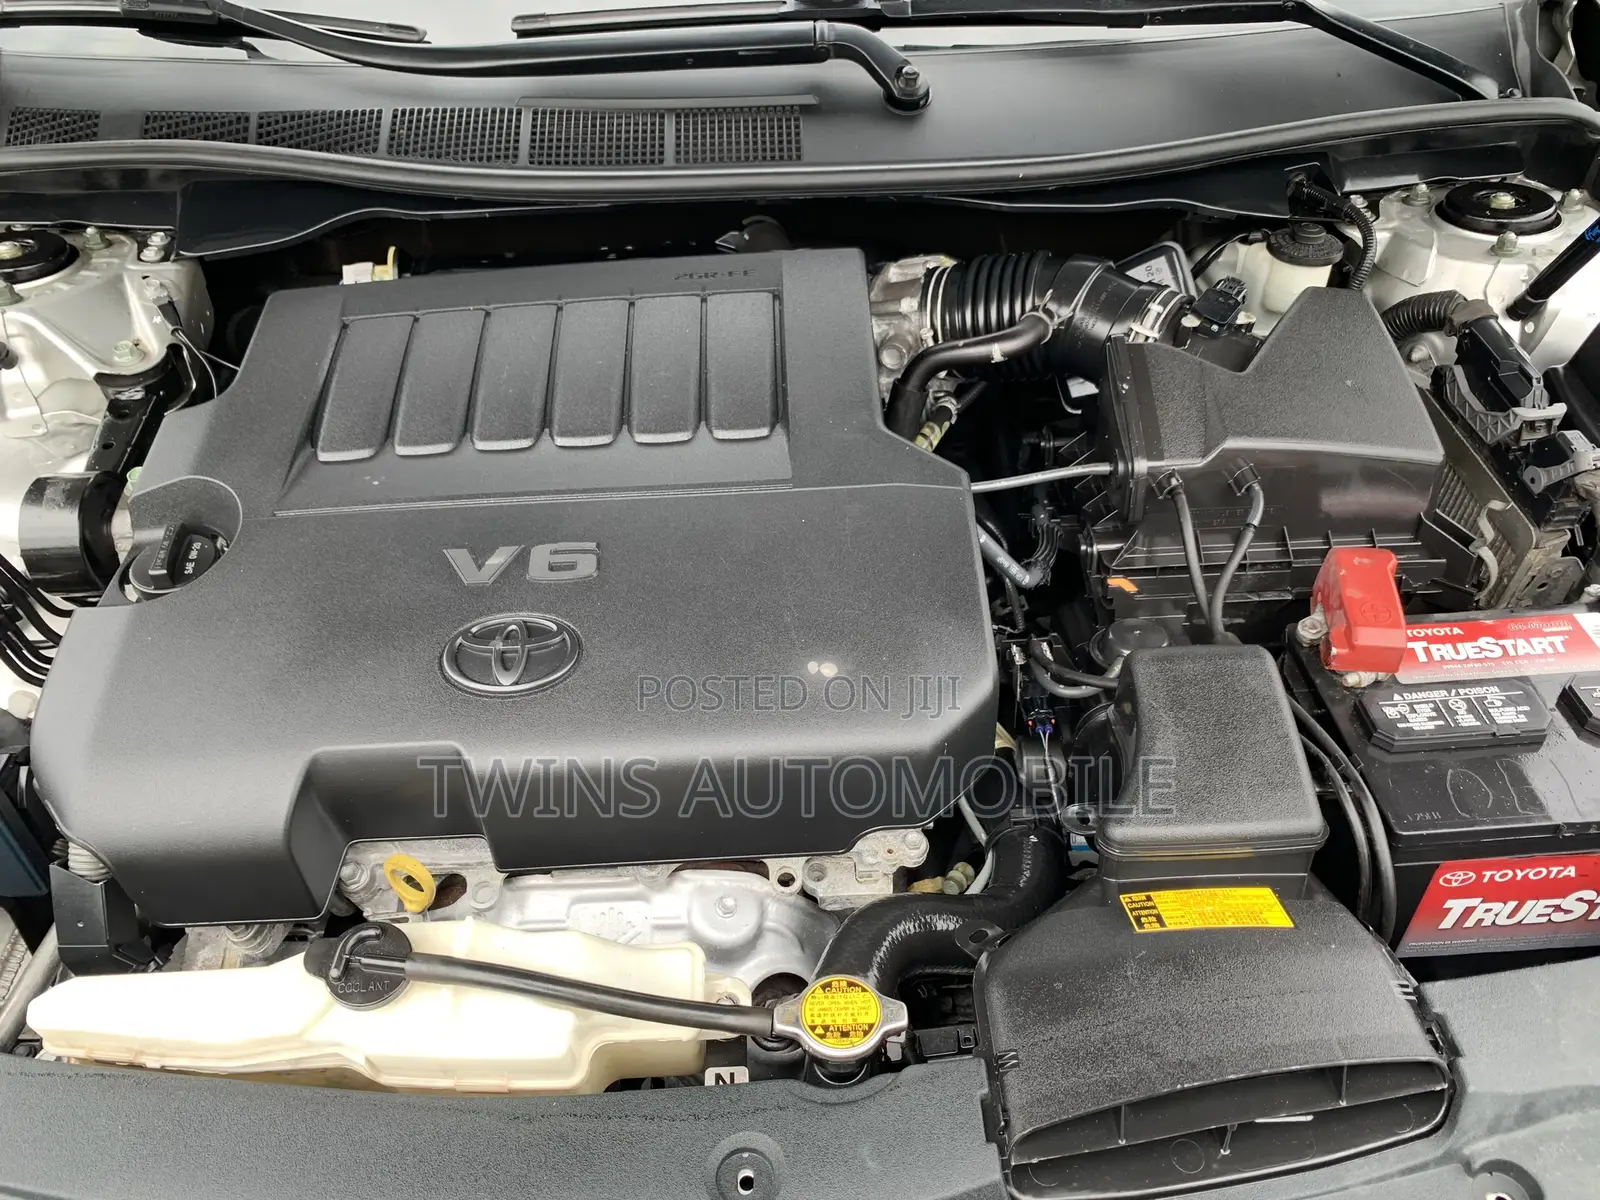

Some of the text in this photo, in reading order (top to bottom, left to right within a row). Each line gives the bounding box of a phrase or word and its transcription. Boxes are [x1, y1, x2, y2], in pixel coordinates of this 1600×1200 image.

[184, 561, 196, 575] SAE
[443, 541, 600, 587] V6
[1402, 690, 1450, 701] DANGER
[1458, 686, 1500, 696] POISON
[1481, 865, 1576, 884] TOYOTA
[1127, 901, 1155, 909] CAUTION
[1132, 908, 1159, 916] ATTENTION
[338, 980, 390, 994] COOLANT
[825, 986, 862, 994] CAUTION
[828, 1024, 869, 1032] ATTENTION
[714, 1072, 735, 1085] N
